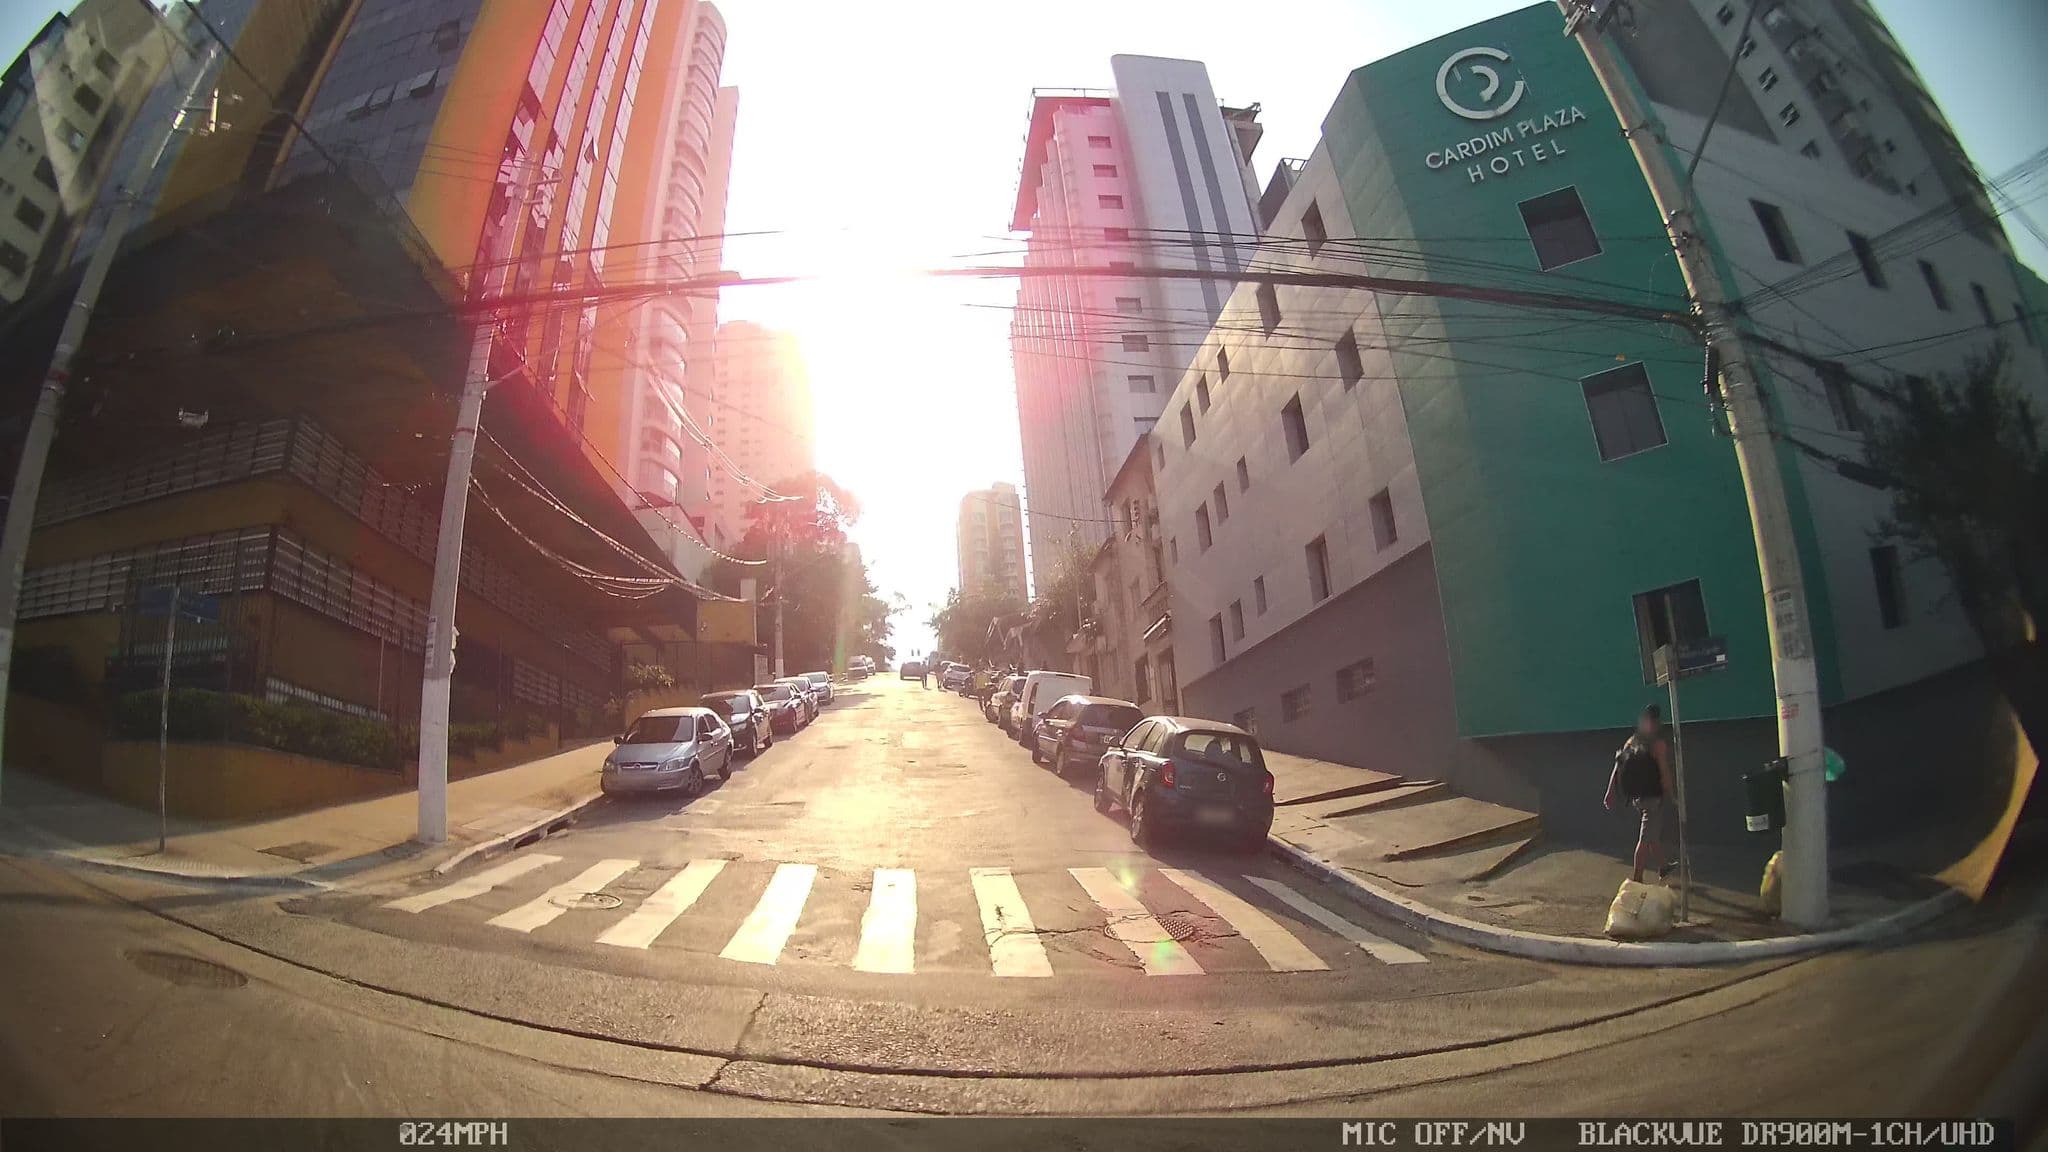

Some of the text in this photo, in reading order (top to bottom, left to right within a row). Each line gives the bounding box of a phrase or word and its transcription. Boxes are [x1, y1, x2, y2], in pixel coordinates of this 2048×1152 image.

[1425, 106, 1587, 169] CARDIM PLAZA
[1467, 139, 1567, 183] HOTEL
